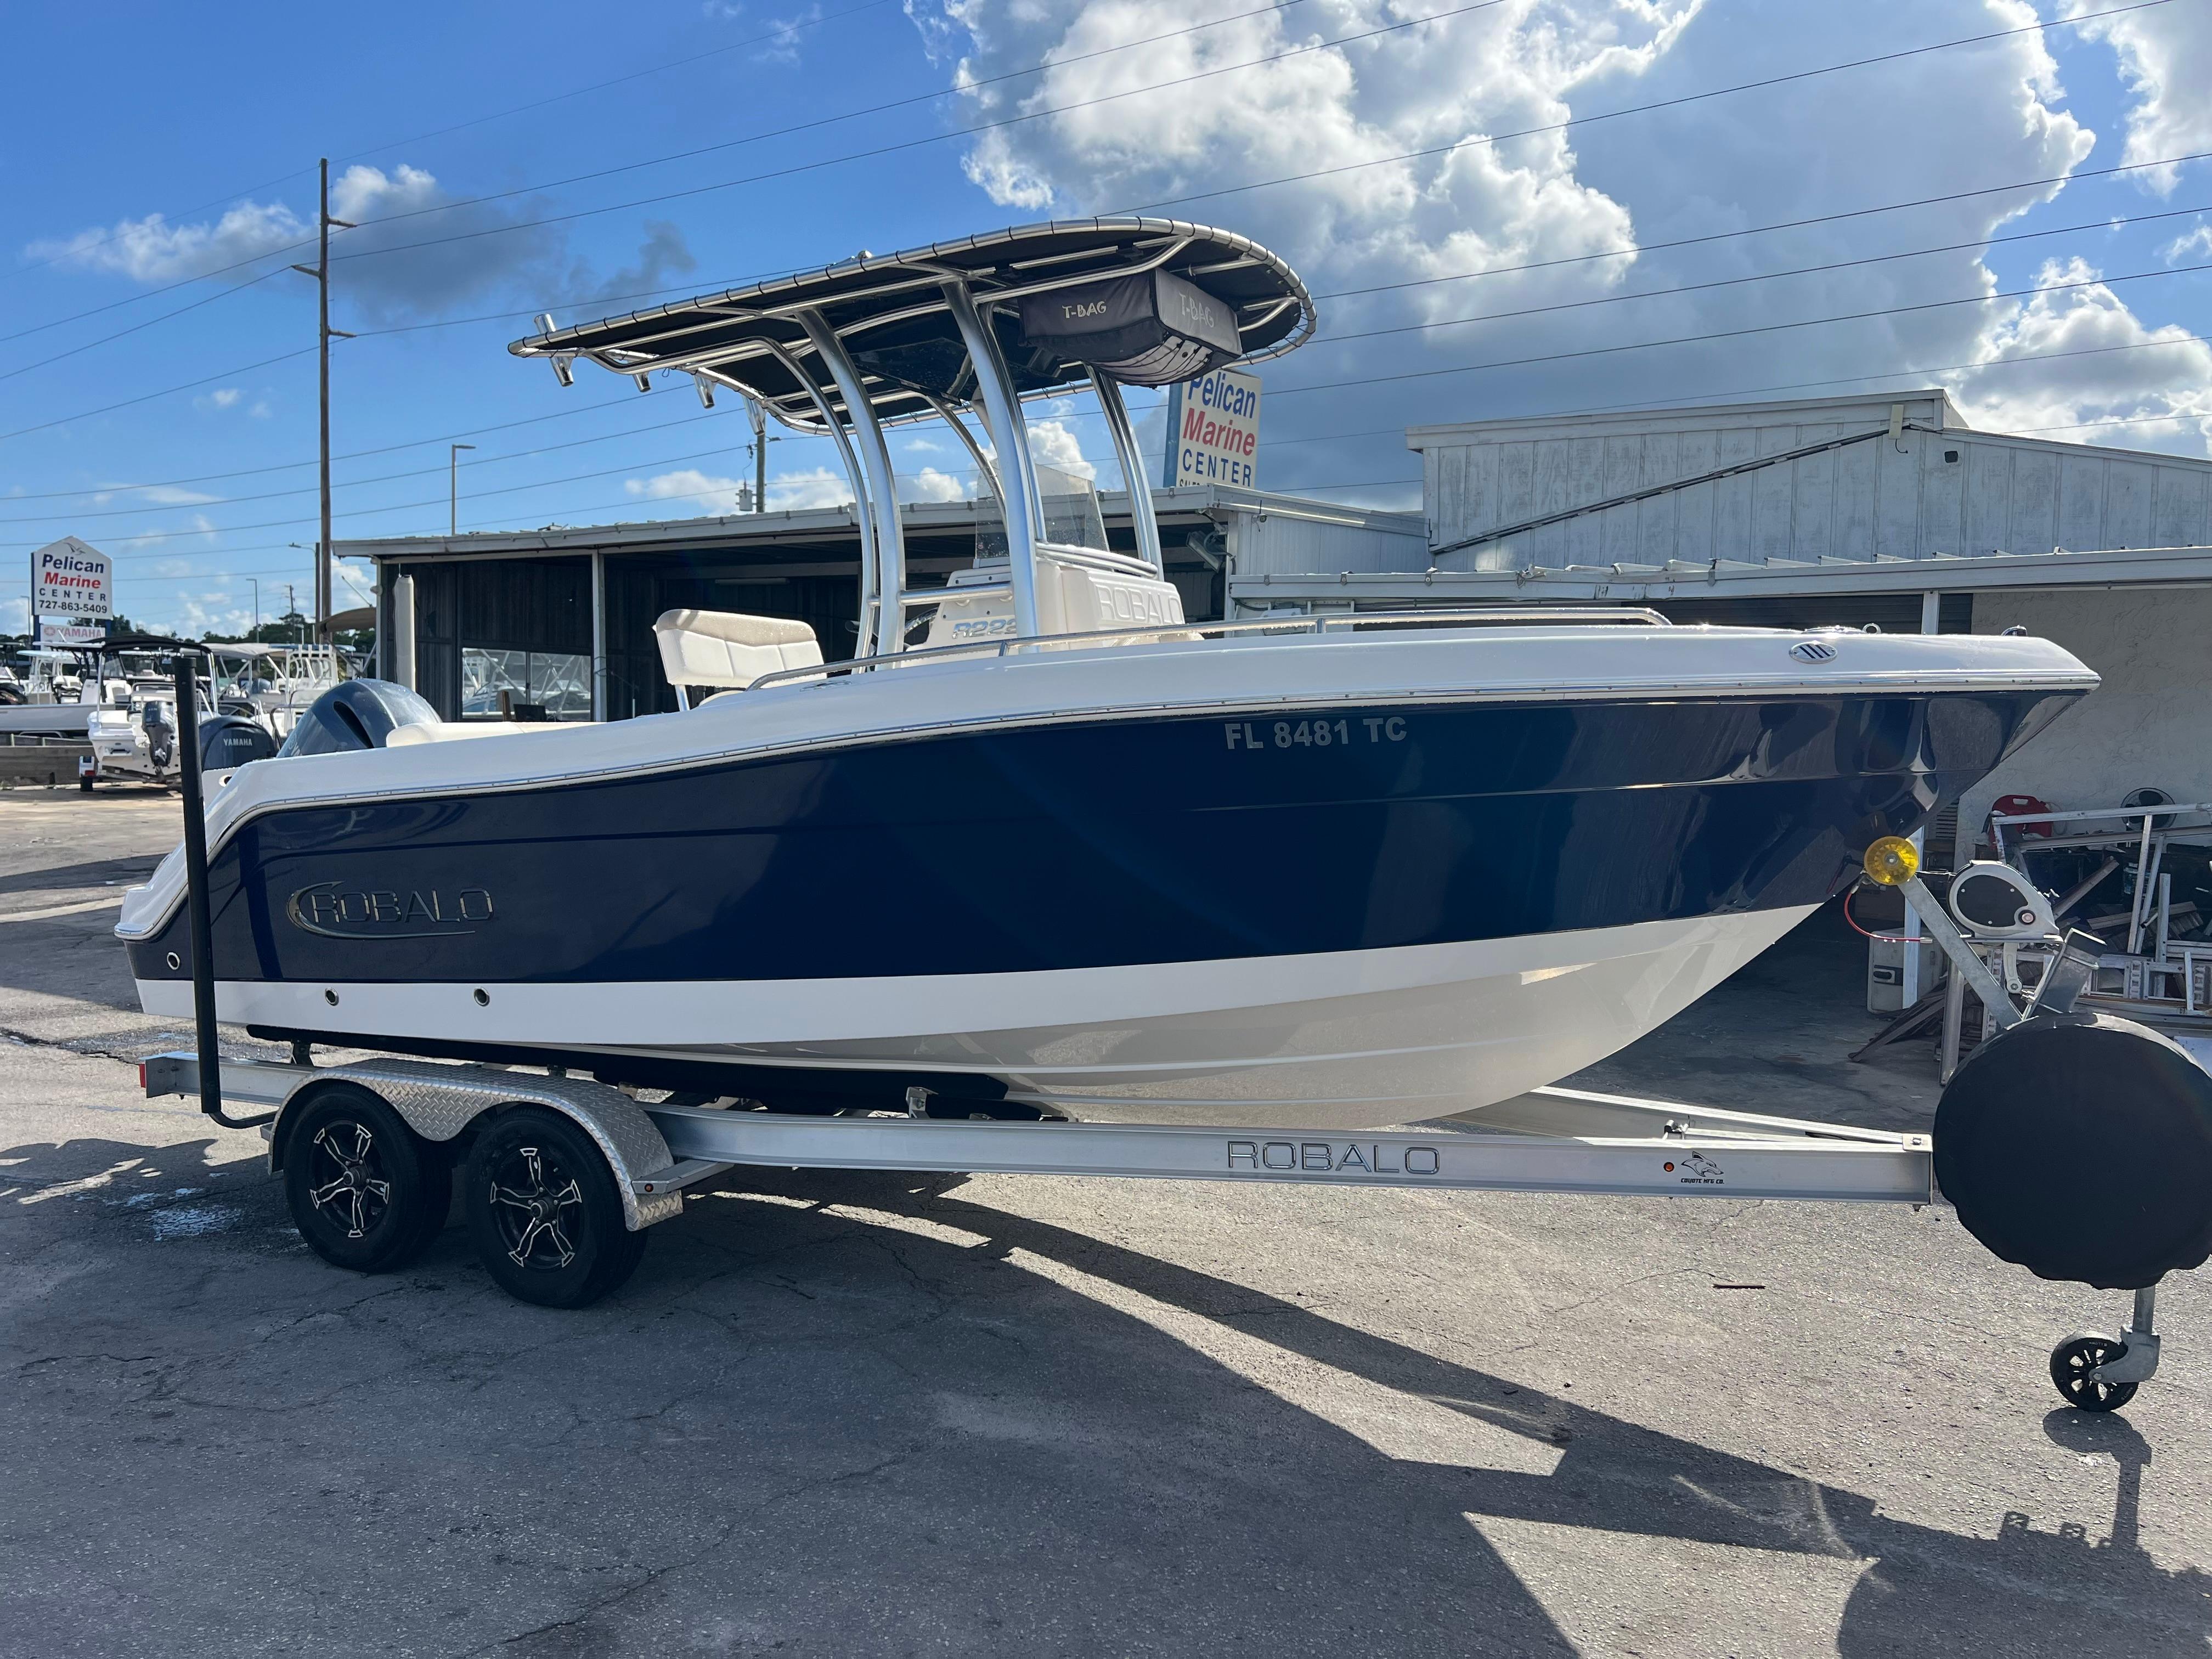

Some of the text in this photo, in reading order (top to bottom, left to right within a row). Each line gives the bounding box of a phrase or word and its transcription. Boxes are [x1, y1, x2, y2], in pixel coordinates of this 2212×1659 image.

[1062, 301, 1107, 319] T-BAG
[1179, 292, 1215, 328] T-BAG
[1188, 371, 1256, 419] Pelican
[1183, 408, 1255, 456] Marine
[1183, 449, 1251, 487] CENTER
[42, 554, 104, 573] Pelican
[39, 588, 106, 601] CENTER
[44, 572, 101, 589] Marine
[39, 600, 107, 613] 727-863-5409
[1095, 584, 1186, 624] ROBALO
[223, 738, 252, 747] YAMAHA
[1224, 716, 1407, 749] FL 8481 TC
[311, 887, 493, 923] ROBALO
[1228, 1141, 1440, 1175] ROBALO
